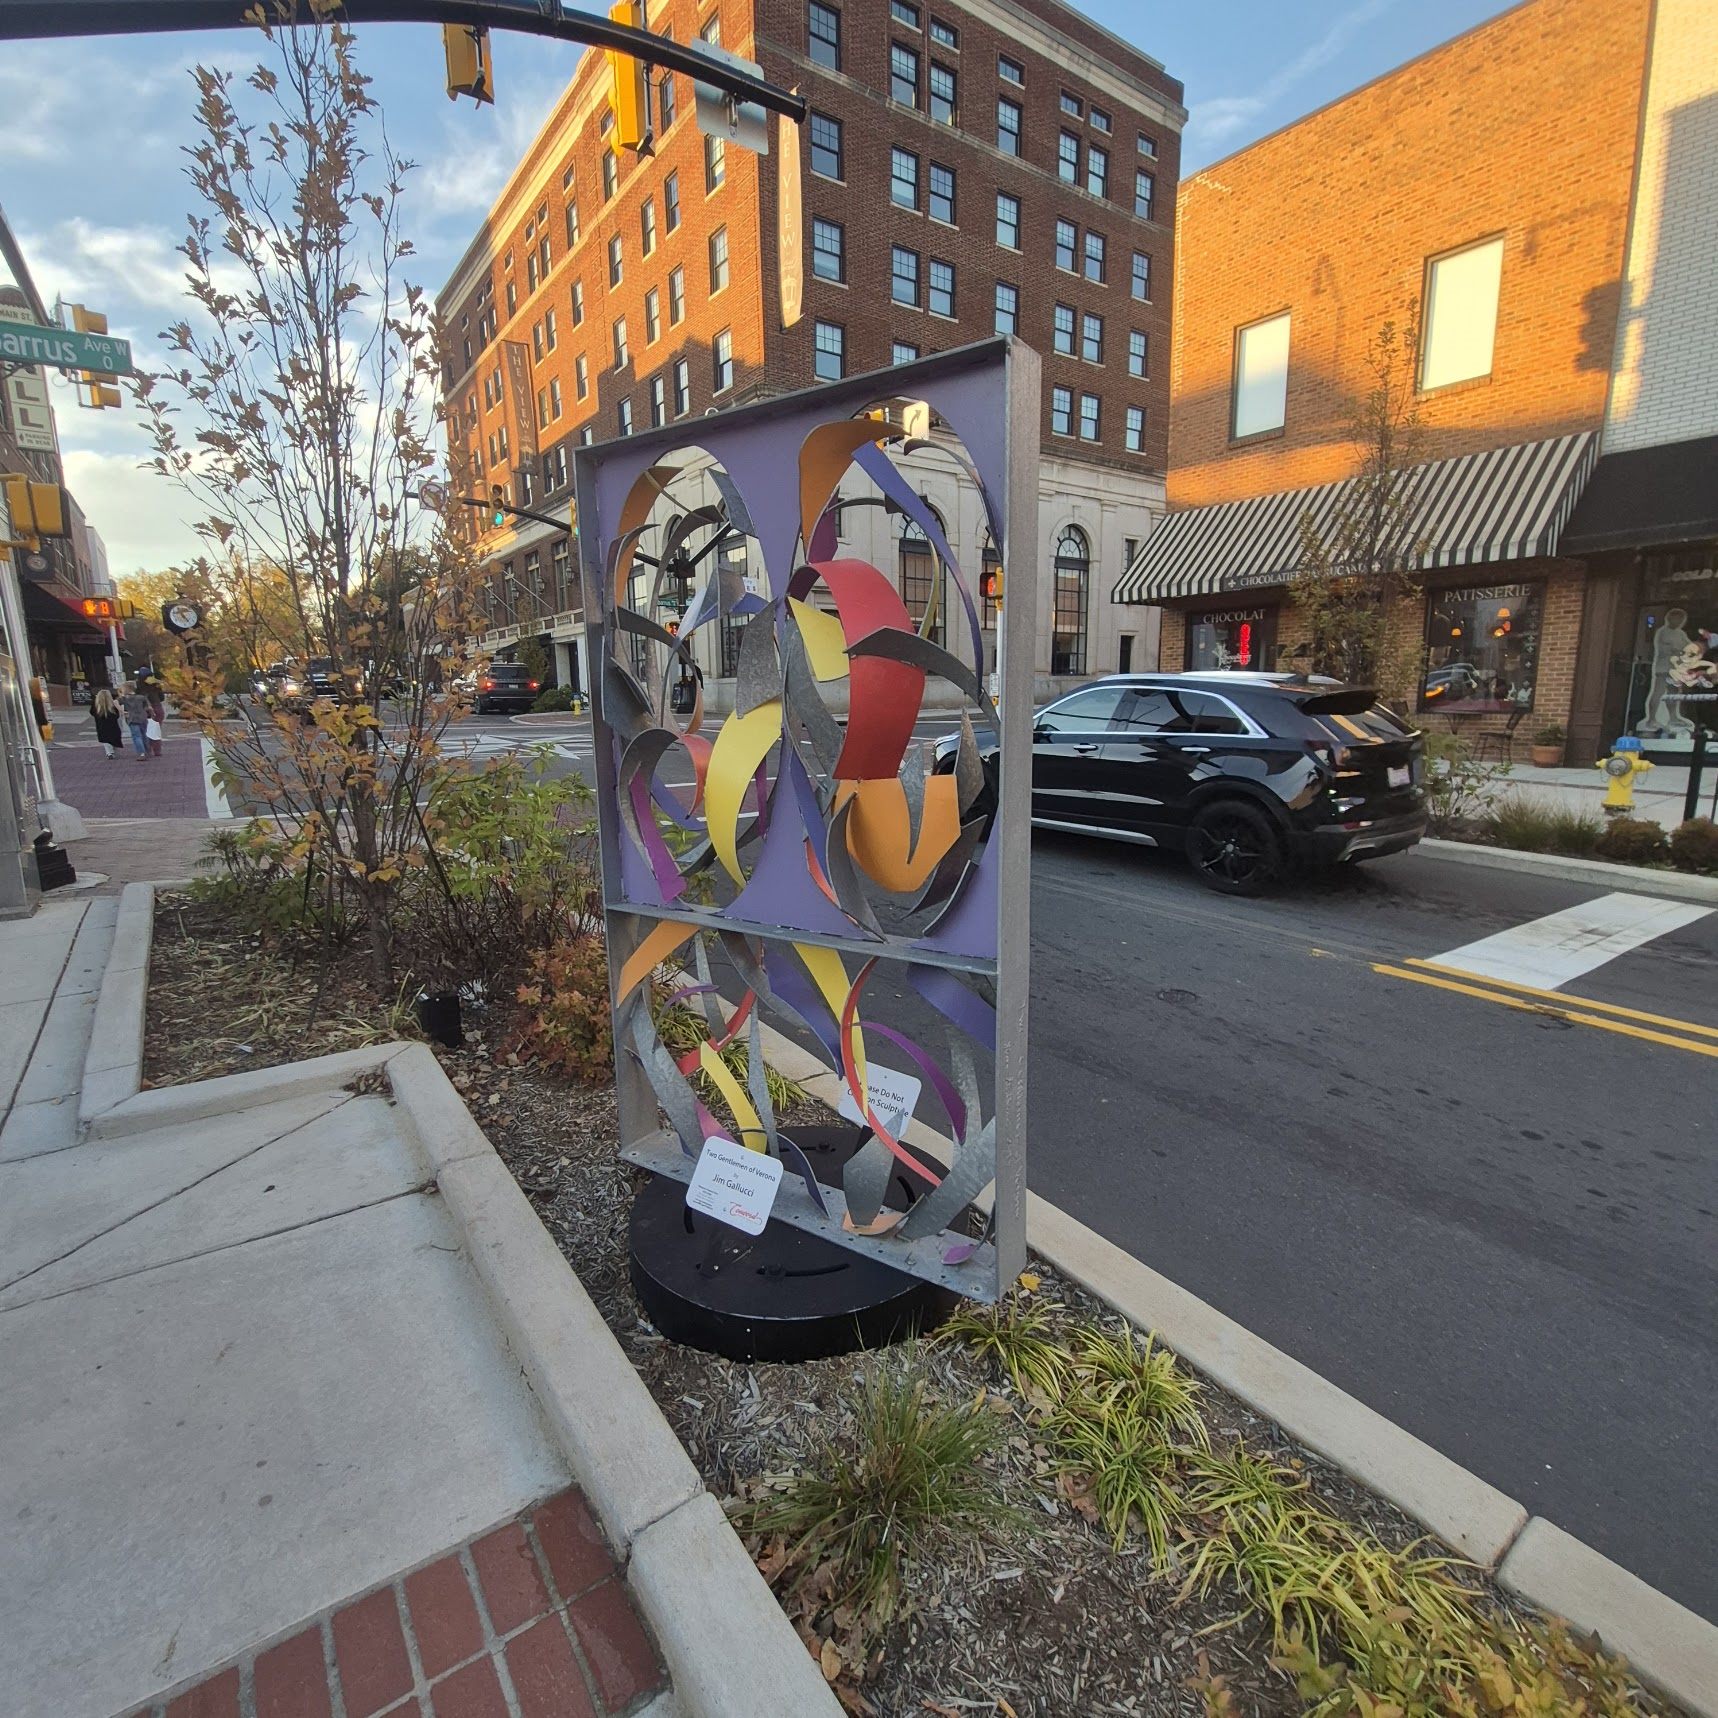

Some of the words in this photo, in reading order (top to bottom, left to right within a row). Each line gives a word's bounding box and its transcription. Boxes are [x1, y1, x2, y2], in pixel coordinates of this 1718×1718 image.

[782, 124, 791, 158] HE
[782, 173, 795, 247] VIEW
[0, 333, 77, 363] arrus
[84, 336, 111, 353] Ave
[114, 341, 127, 356] W
[512, 345, 521, 377] THE
[517, 385, 530, 429] VIEW
[1444, 583, 1531, 602] PATISSERIE
[1203, 608, 1267, 624] CHOCOLAT
[876, 1100, 909, 1117] Sculpte
[880, 1088, 891, 1098] Do
[891, 1092, 904, 1103] Not
[706, 1149, 718, 1158] Two
[717, 1154, 748, 1171] Gentlemen
[755, 1170, 776, 1182] Verona
[712, 1174, 726, 1185] Jim
[726, 1179, 755, 1197] Gallucci
